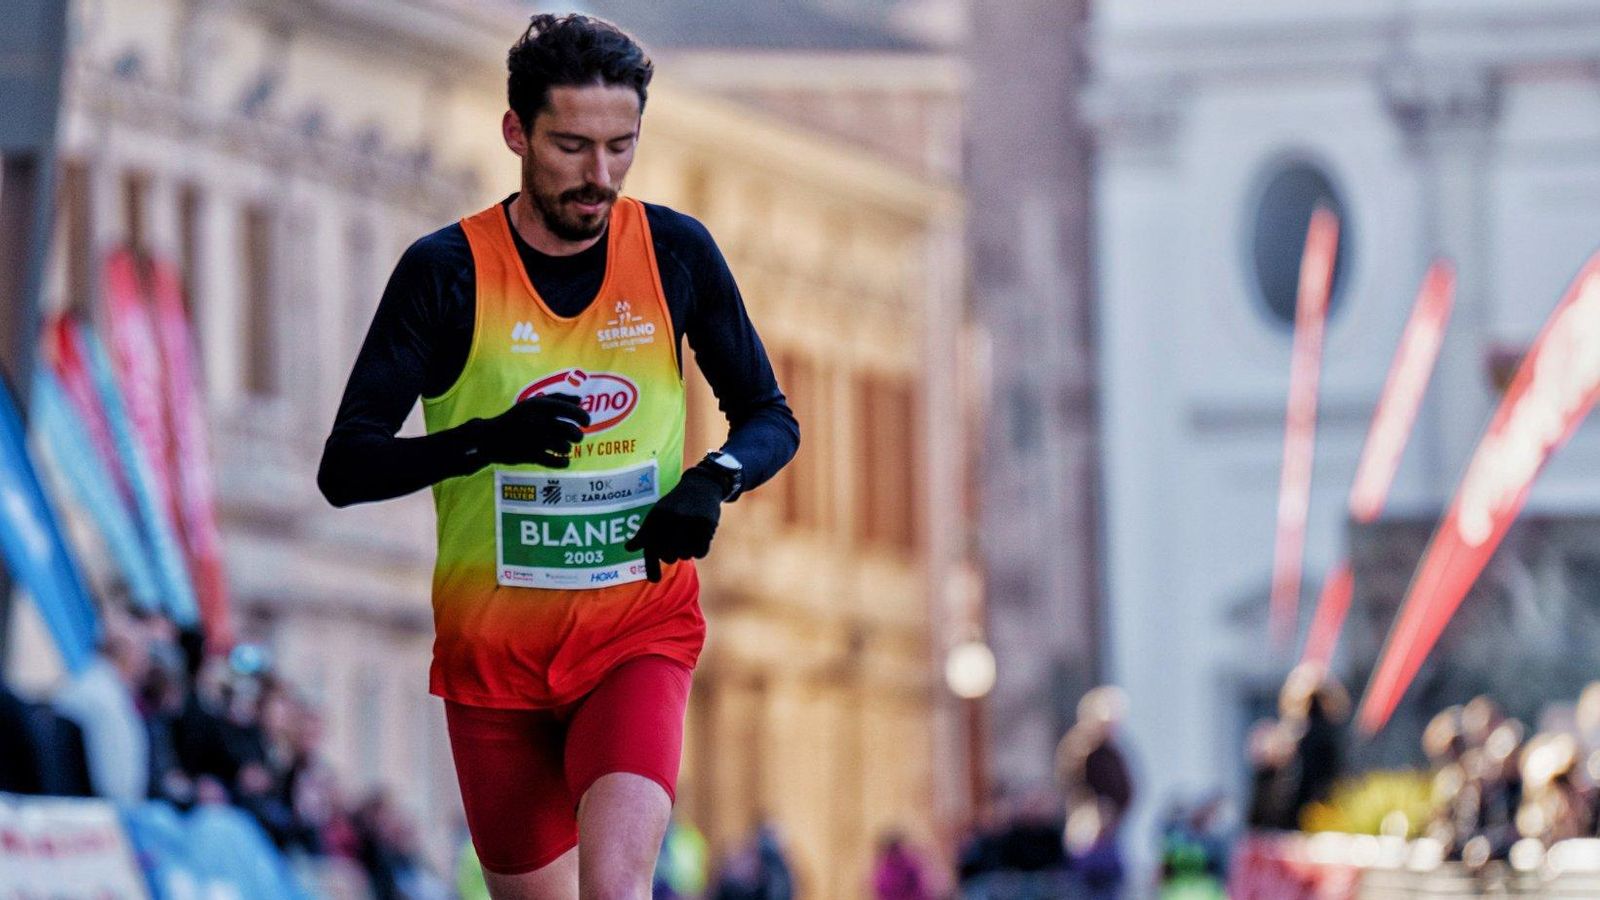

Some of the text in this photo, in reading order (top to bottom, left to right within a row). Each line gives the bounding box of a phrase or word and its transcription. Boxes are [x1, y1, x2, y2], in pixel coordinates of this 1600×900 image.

[597, 322, 656, 343] SERRANO
[586, 443, 594, 457] Y
[597, 439, 637, 456] CORRE
[589, 479, 613, 492] 10K
[504, 492, 535, 500] FILTER
[565, 494, 577, 503] DE
[581, 489, 633, 502] ZARAGOZA
[520, 514, 641, 547] BLANES
[563, 550, 605, 565] 2003
[590, 569, 619, 582] HOKA
